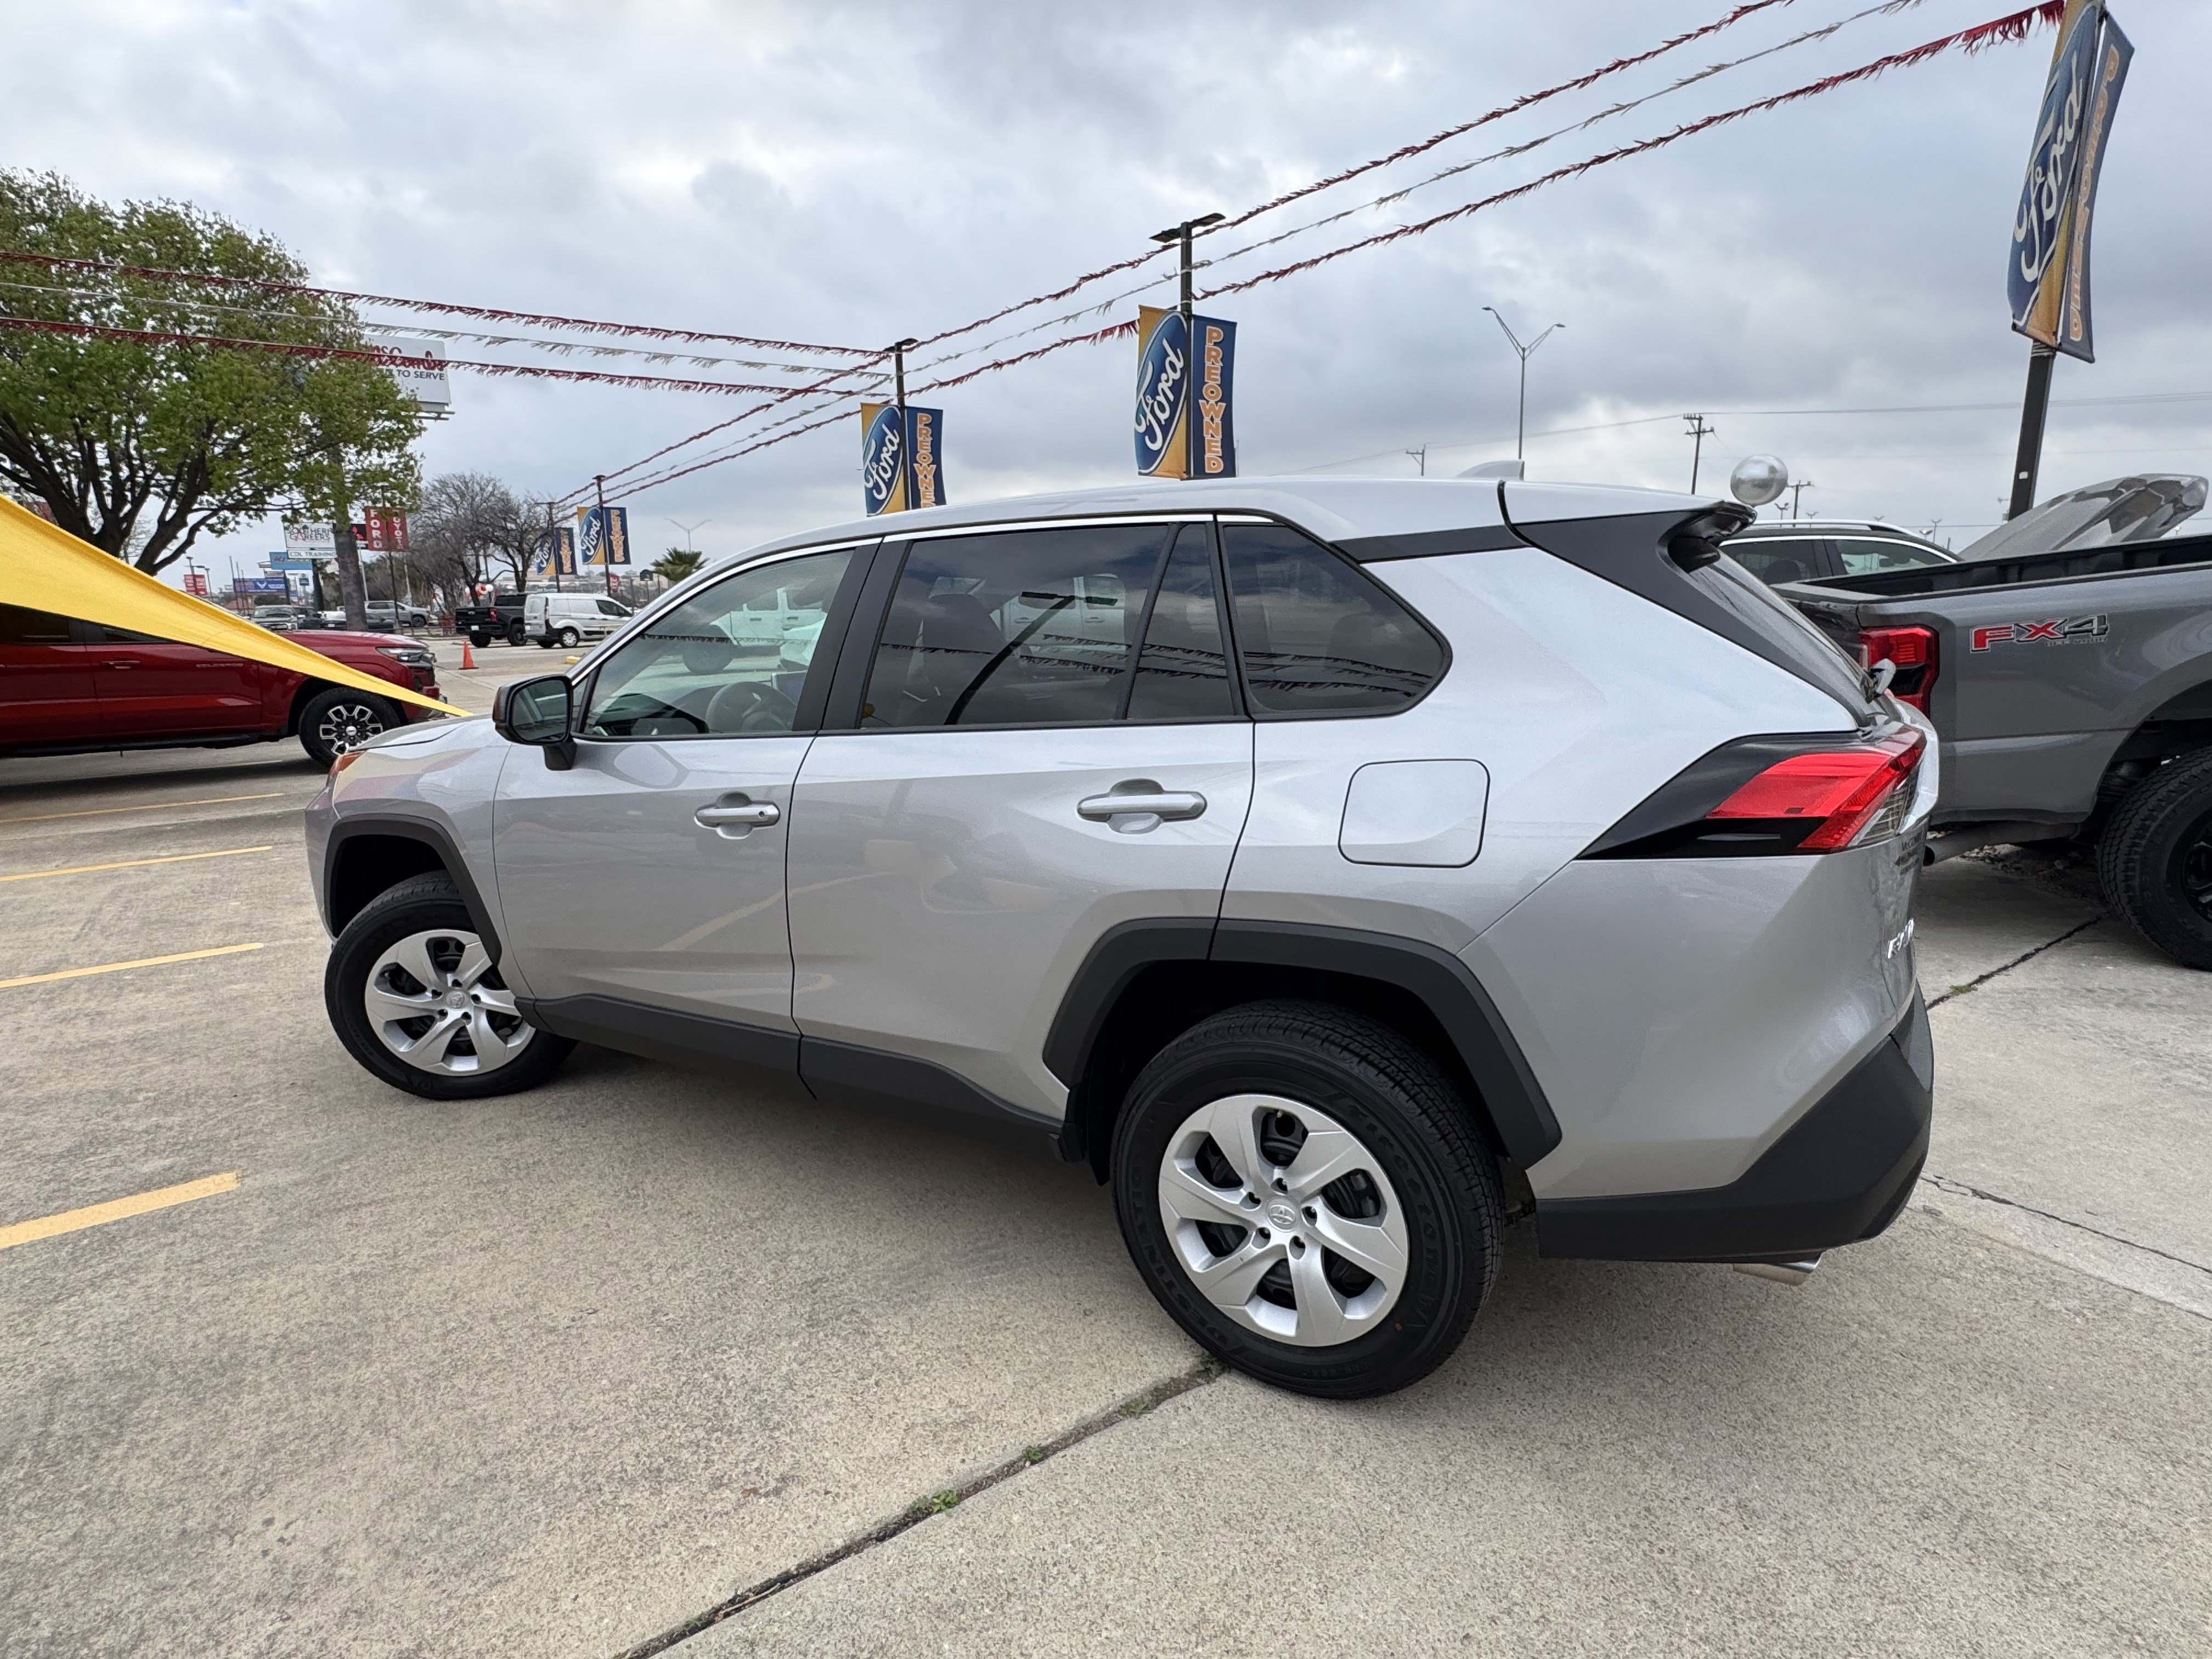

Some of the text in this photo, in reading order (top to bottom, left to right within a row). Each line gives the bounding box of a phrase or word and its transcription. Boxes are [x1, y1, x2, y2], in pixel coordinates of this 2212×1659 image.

[2015, 50, 2083, 283] Ford
[396, 369, 411, 377] TO
[414, 370, 445, 381] SERVE
[1135, 337, 1184, 451] Ford
[1198, 326, 1227, 473] PREOWNED
[864, 423, 900, 500] Ford
[370, 509, 383, 549] FORD
[580, 516, 601, 556] Ford
[1970, 613, 2109, 653] FX4
